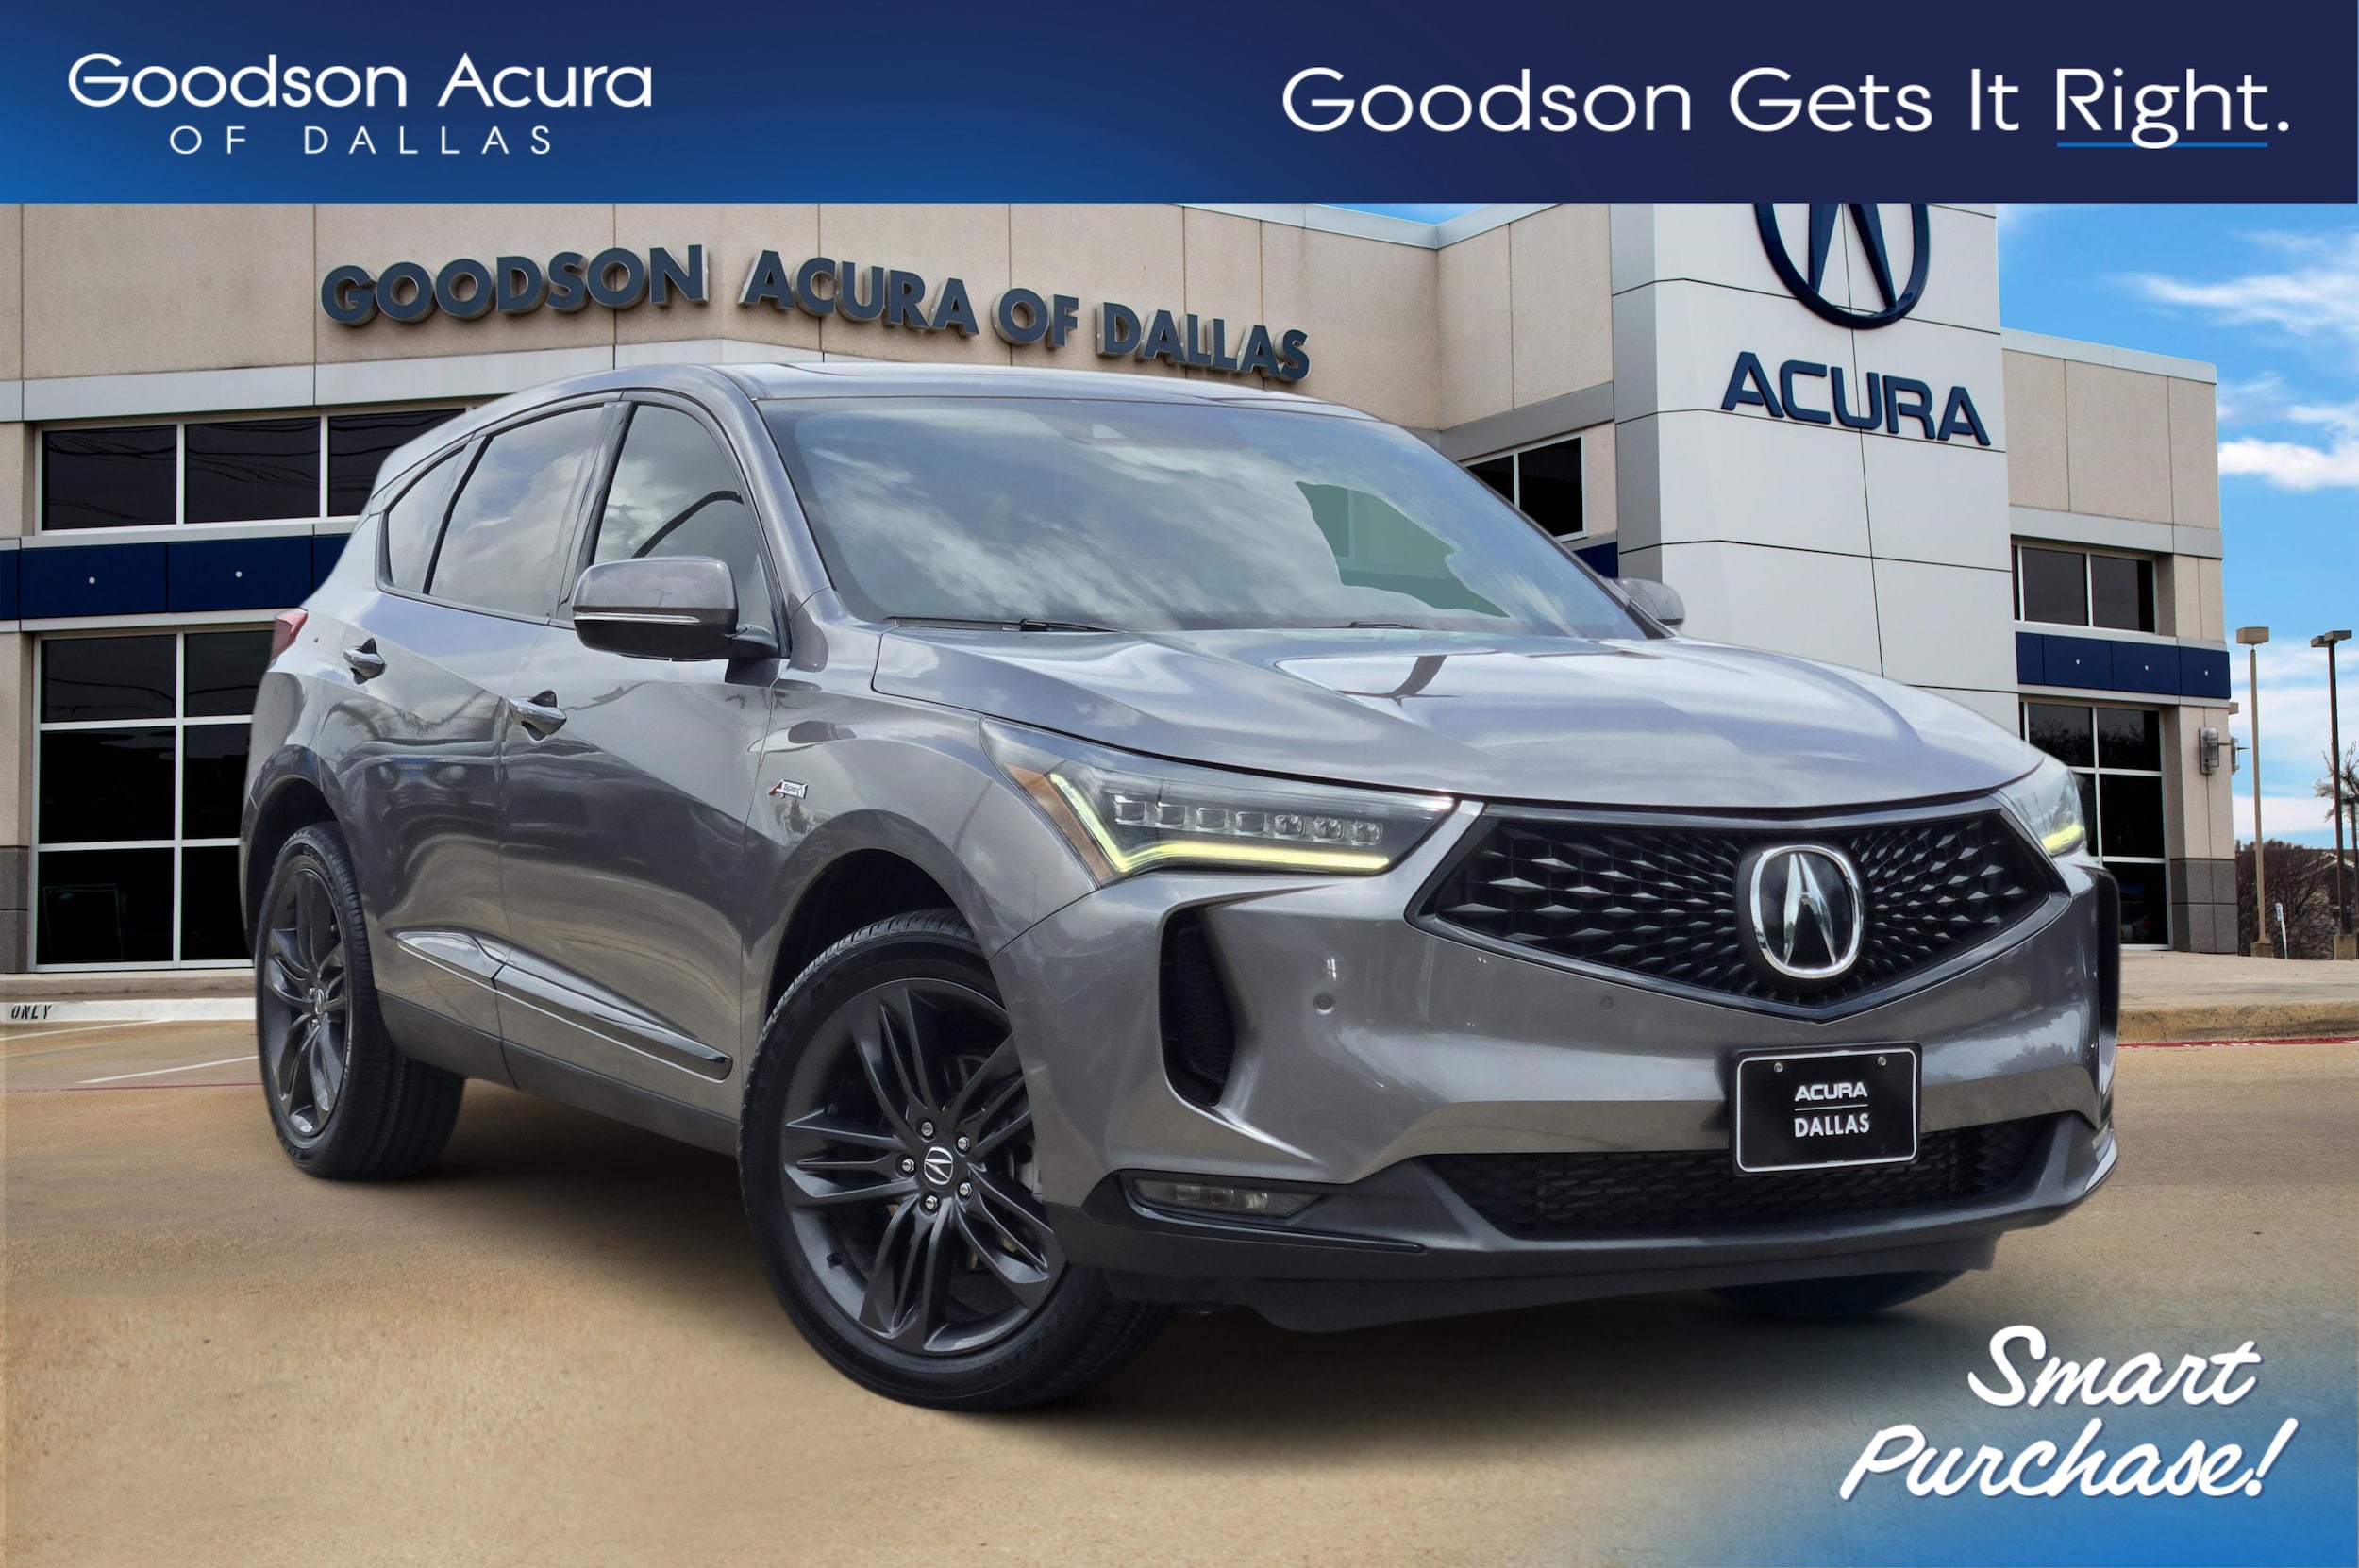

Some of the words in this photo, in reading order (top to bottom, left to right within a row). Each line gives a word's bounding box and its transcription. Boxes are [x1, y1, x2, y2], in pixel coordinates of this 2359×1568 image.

[321, 243, 709, 325] GOODSON
[738, 249, 979, 336] ACURA
[991, 287, 1079, 349] OF
[1096, 301, 1310, 381] DALLAS
[1720, 351, 1991, 446] ACURA
[11, 1004, 52, 1019] ONLY
[1794, 1081, 1868, 1102] ACURA
[1794, 1112, 1870, 1138] DALLAS
